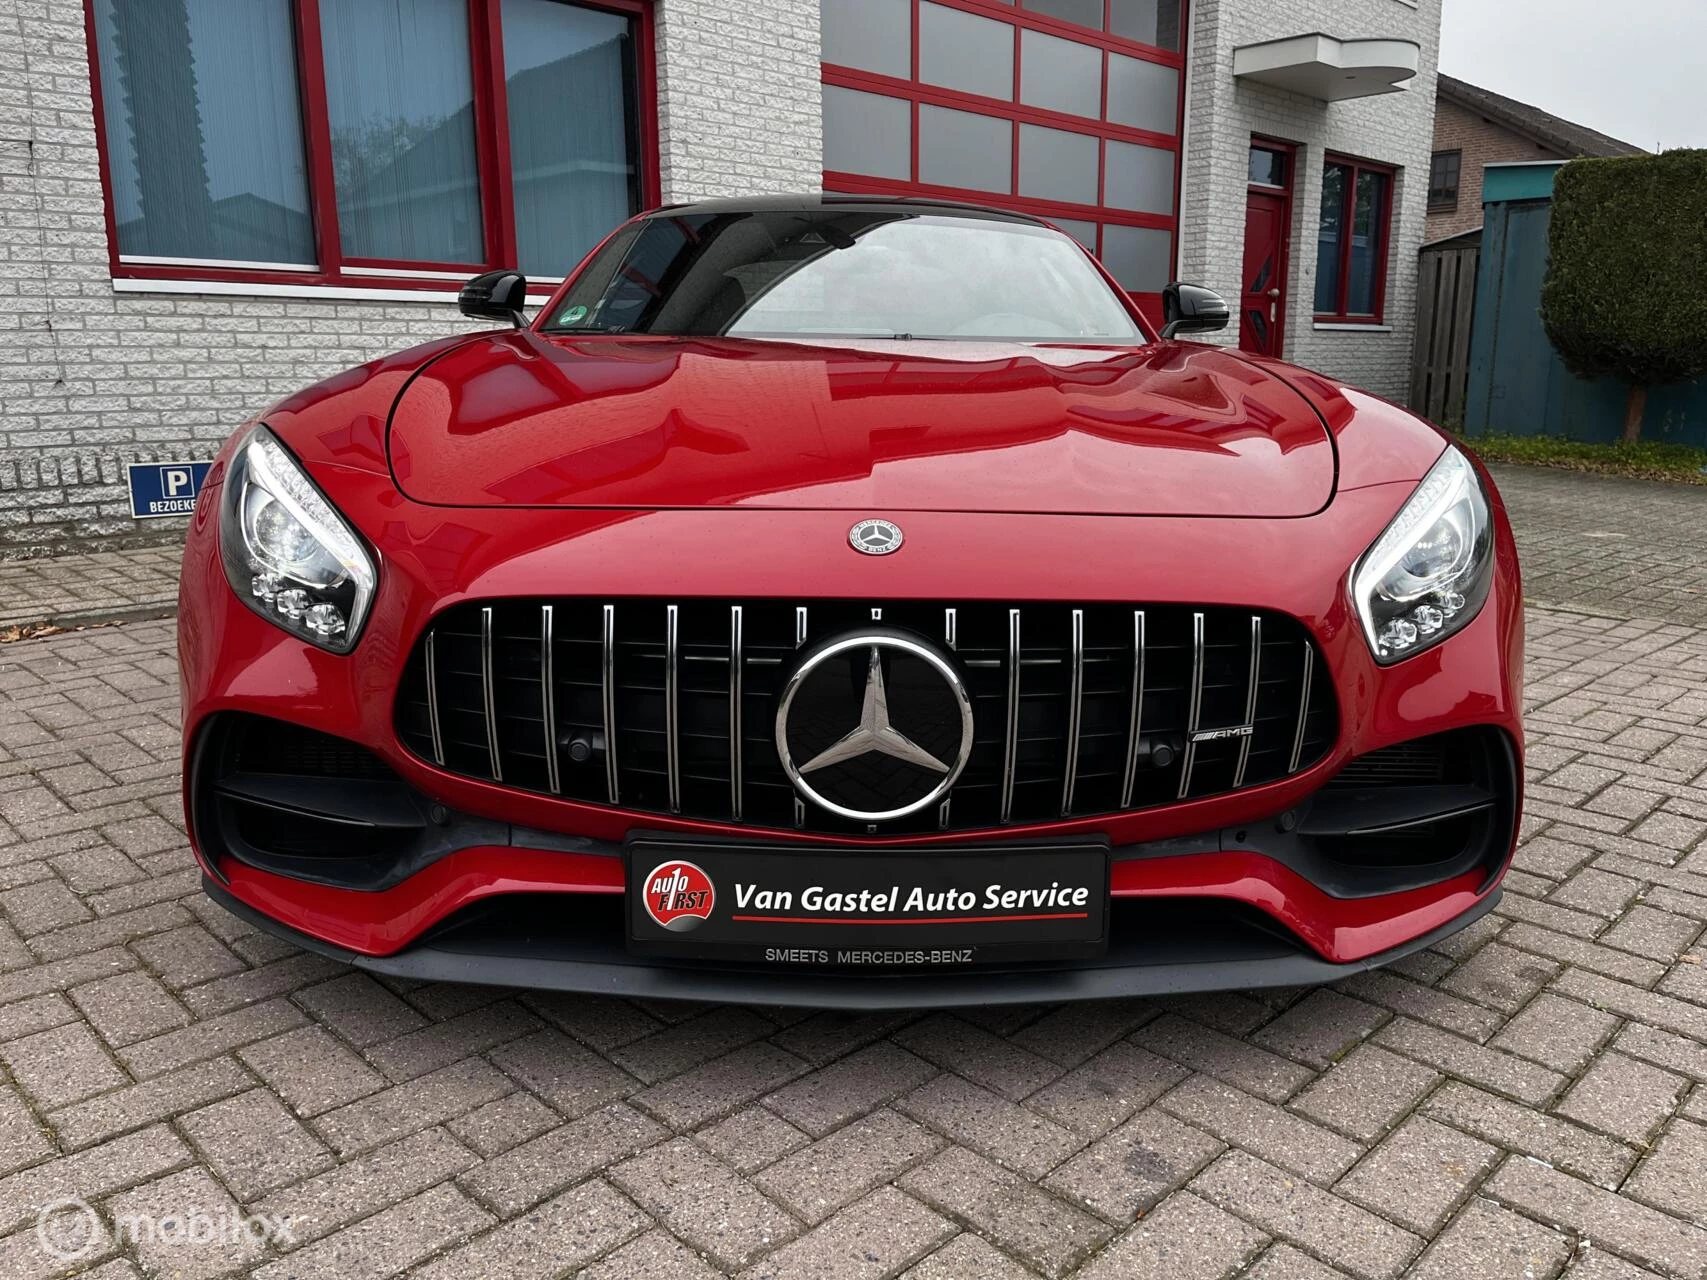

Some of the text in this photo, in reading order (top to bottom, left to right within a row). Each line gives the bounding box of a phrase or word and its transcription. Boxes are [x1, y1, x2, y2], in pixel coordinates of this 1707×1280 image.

[167, 470, 188, 496] P
[735, 881, 1089, 912] Van Gastel Auto Service
[765, 948, 973, 964] SMEETS MERCEDES-BENZ
